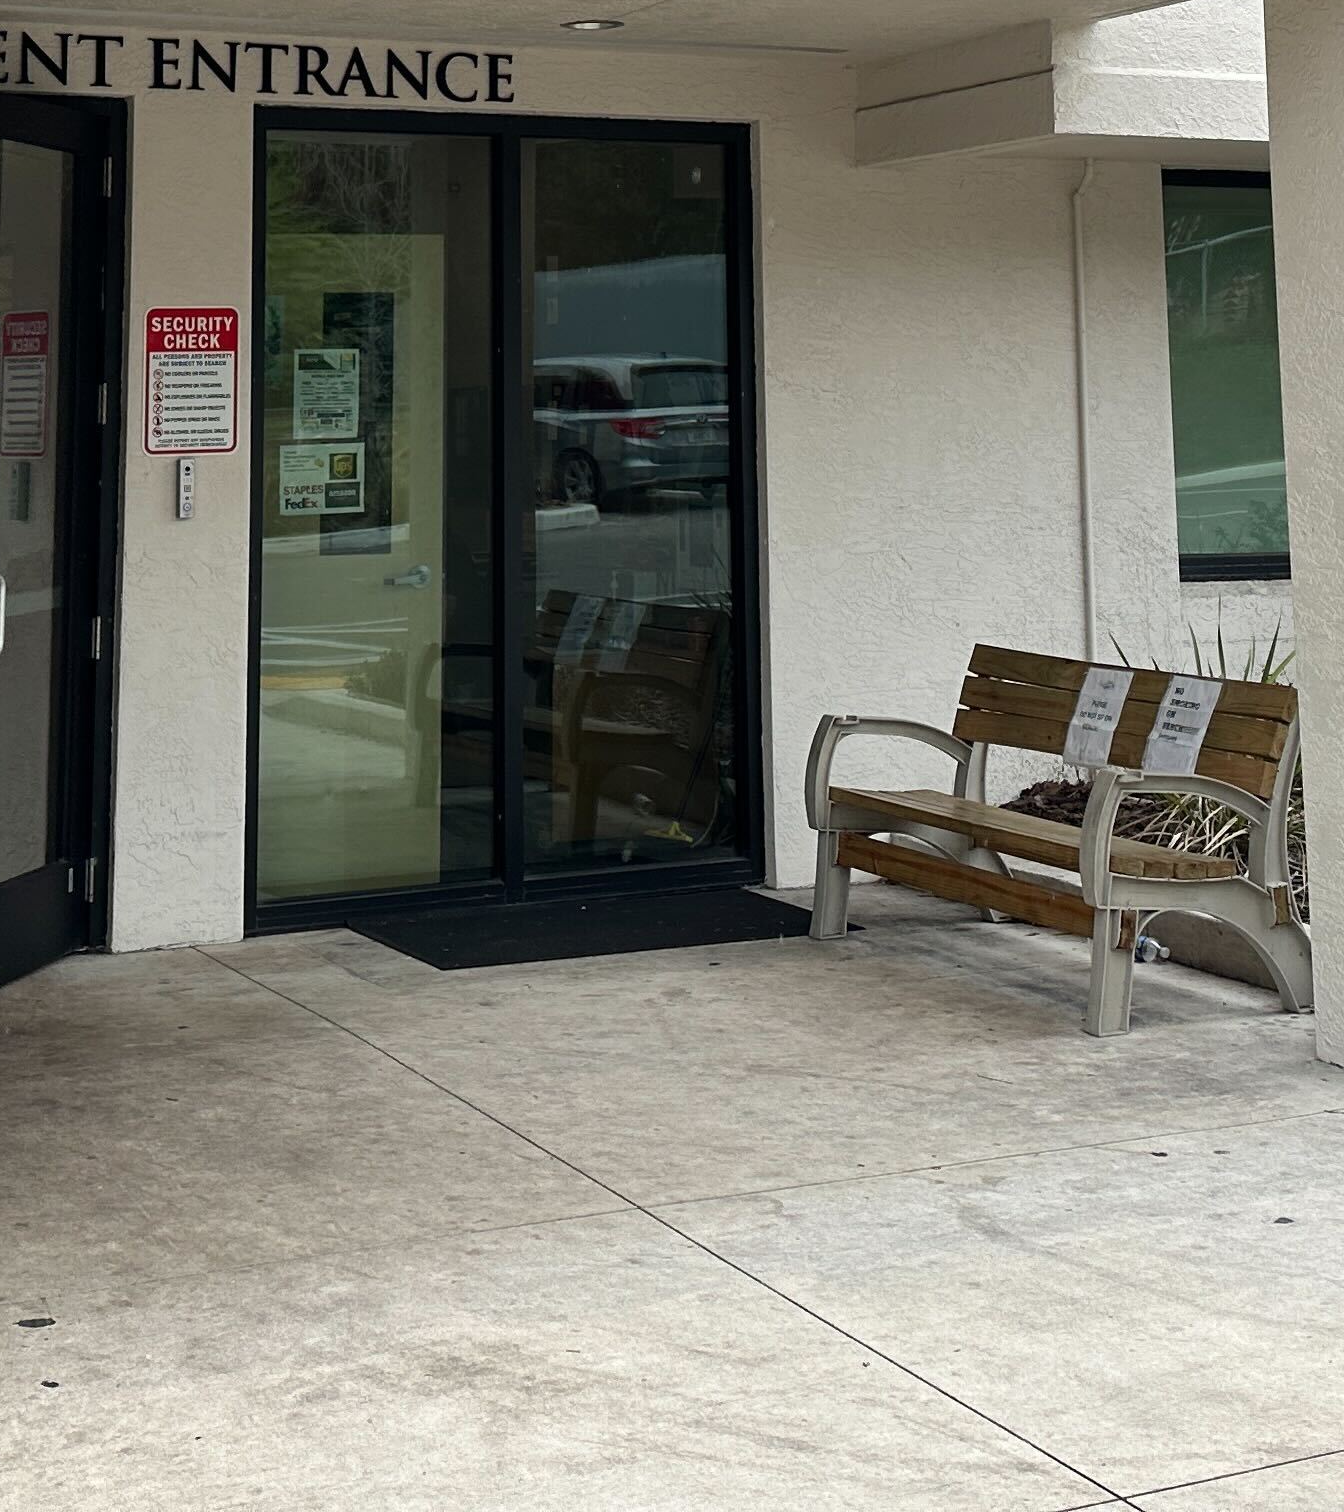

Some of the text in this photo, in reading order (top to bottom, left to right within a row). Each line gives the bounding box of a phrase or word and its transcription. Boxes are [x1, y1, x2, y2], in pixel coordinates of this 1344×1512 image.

[147, 37, 515, 103] ENTRANCE
[151, 316, 233, 332] SECURITY
[163, 333, 221, 349] CHECK
[283, 485, 324, 496] STAPLES
[285, 497, 319, 510] FedEx
